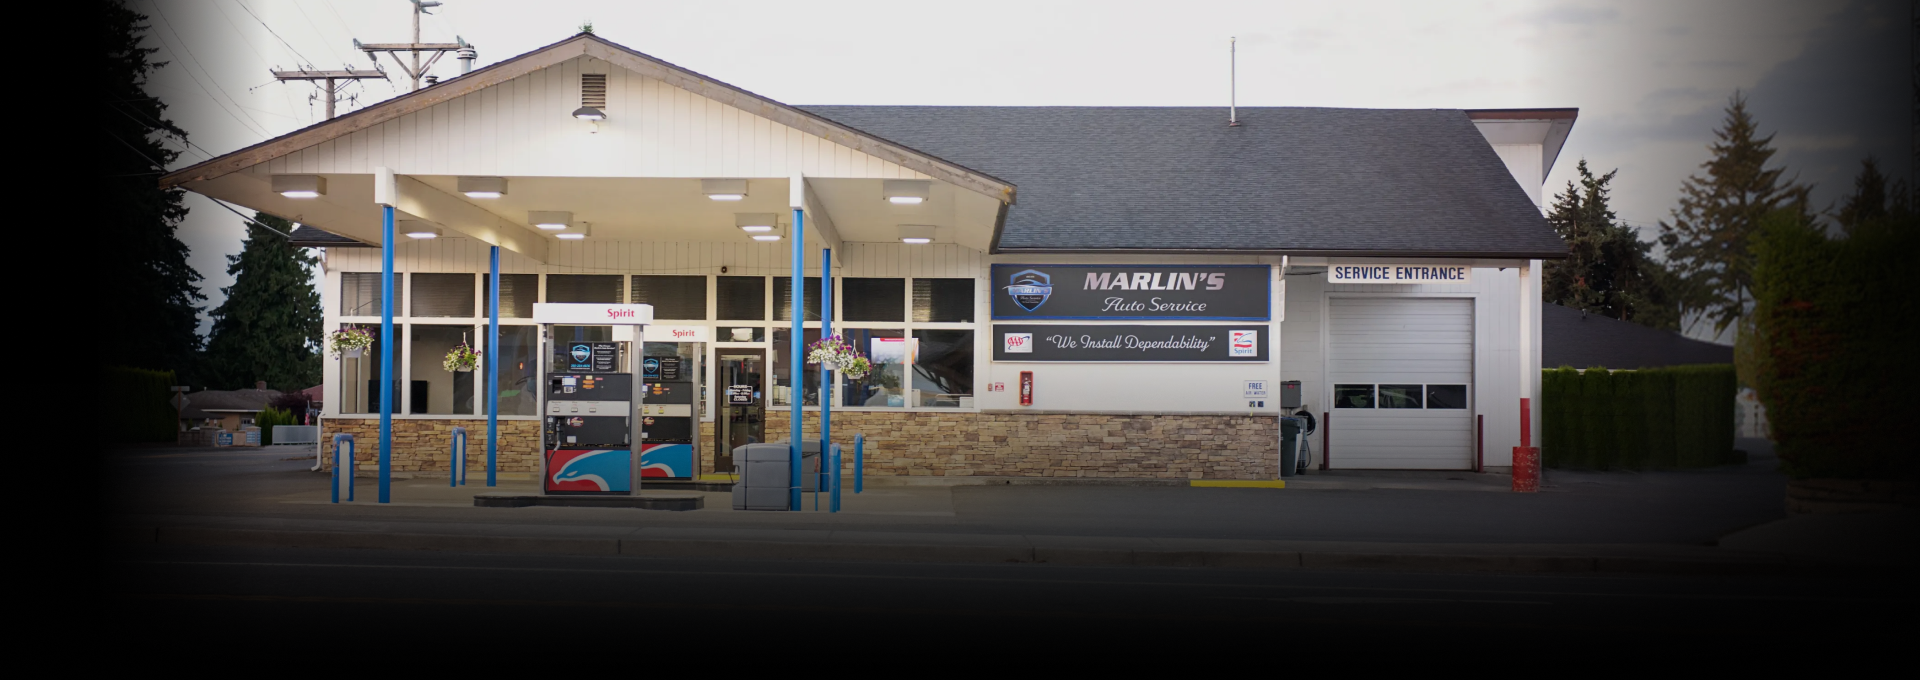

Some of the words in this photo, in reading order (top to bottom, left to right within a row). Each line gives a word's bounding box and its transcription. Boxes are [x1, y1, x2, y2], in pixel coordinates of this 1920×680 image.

[1335, 266, 1390, 280] SERVICE
[1395, 267, 1465, 280] ENTRANCE
[1083, 272, 1226, 291] MARLIN'S
[1101, 297, 1146, 312] Auto
[1148, 297, 1207, 312] Service
[607, 308, 635, 319] Spirit
[672, 329, 695, 338] Spirit
[1007, 336, 1024, 347] AAA
[1046, 335, 1077, 349] "We
[1081, 334, 1122, 349] Install
[1124, 335, 1216, 352] Dependability"
[1248, 382, 1263, 390] FREE
